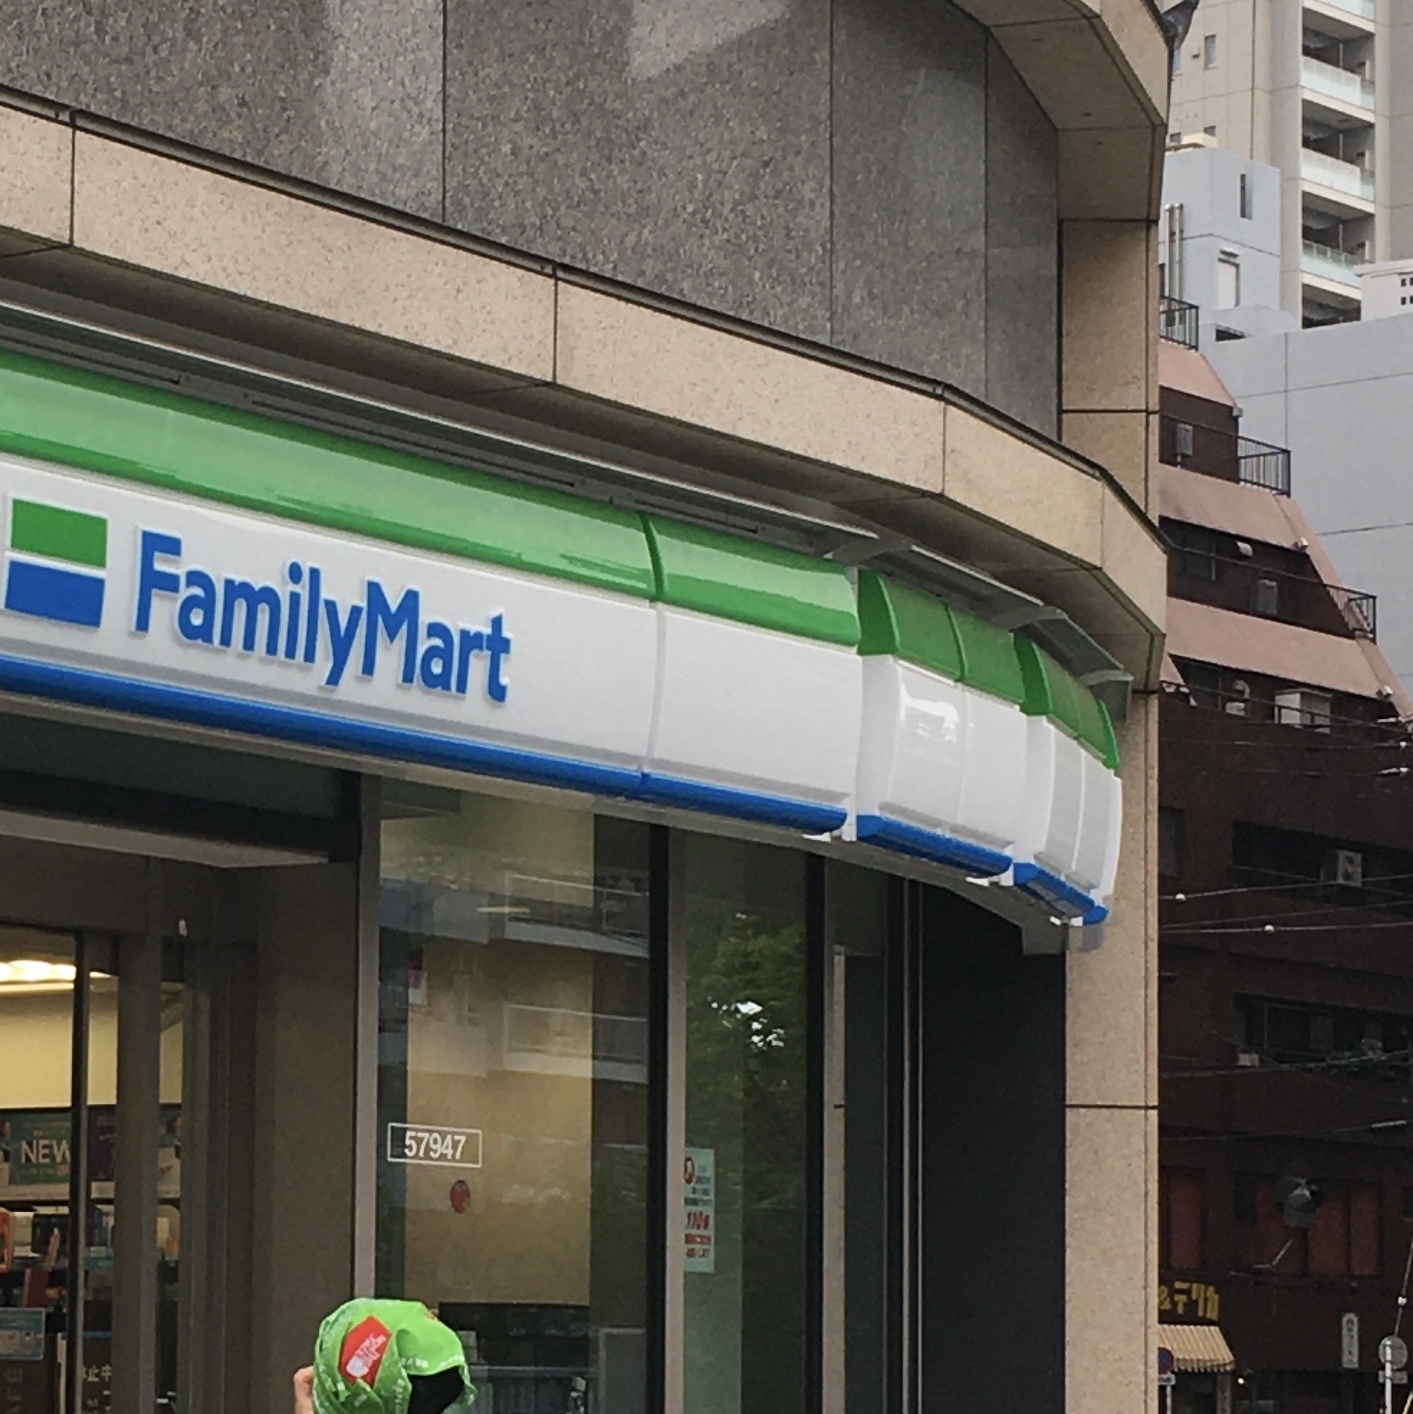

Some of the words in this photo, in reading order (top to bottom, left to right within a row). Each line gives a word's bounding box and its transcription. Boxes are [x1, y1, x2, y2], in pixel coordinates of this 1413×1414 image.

[133, 527, 512, 702] FamilyMart
[21, 1138, 71, 1164] NEW
[404, 1131, 466, 1160] 57947
